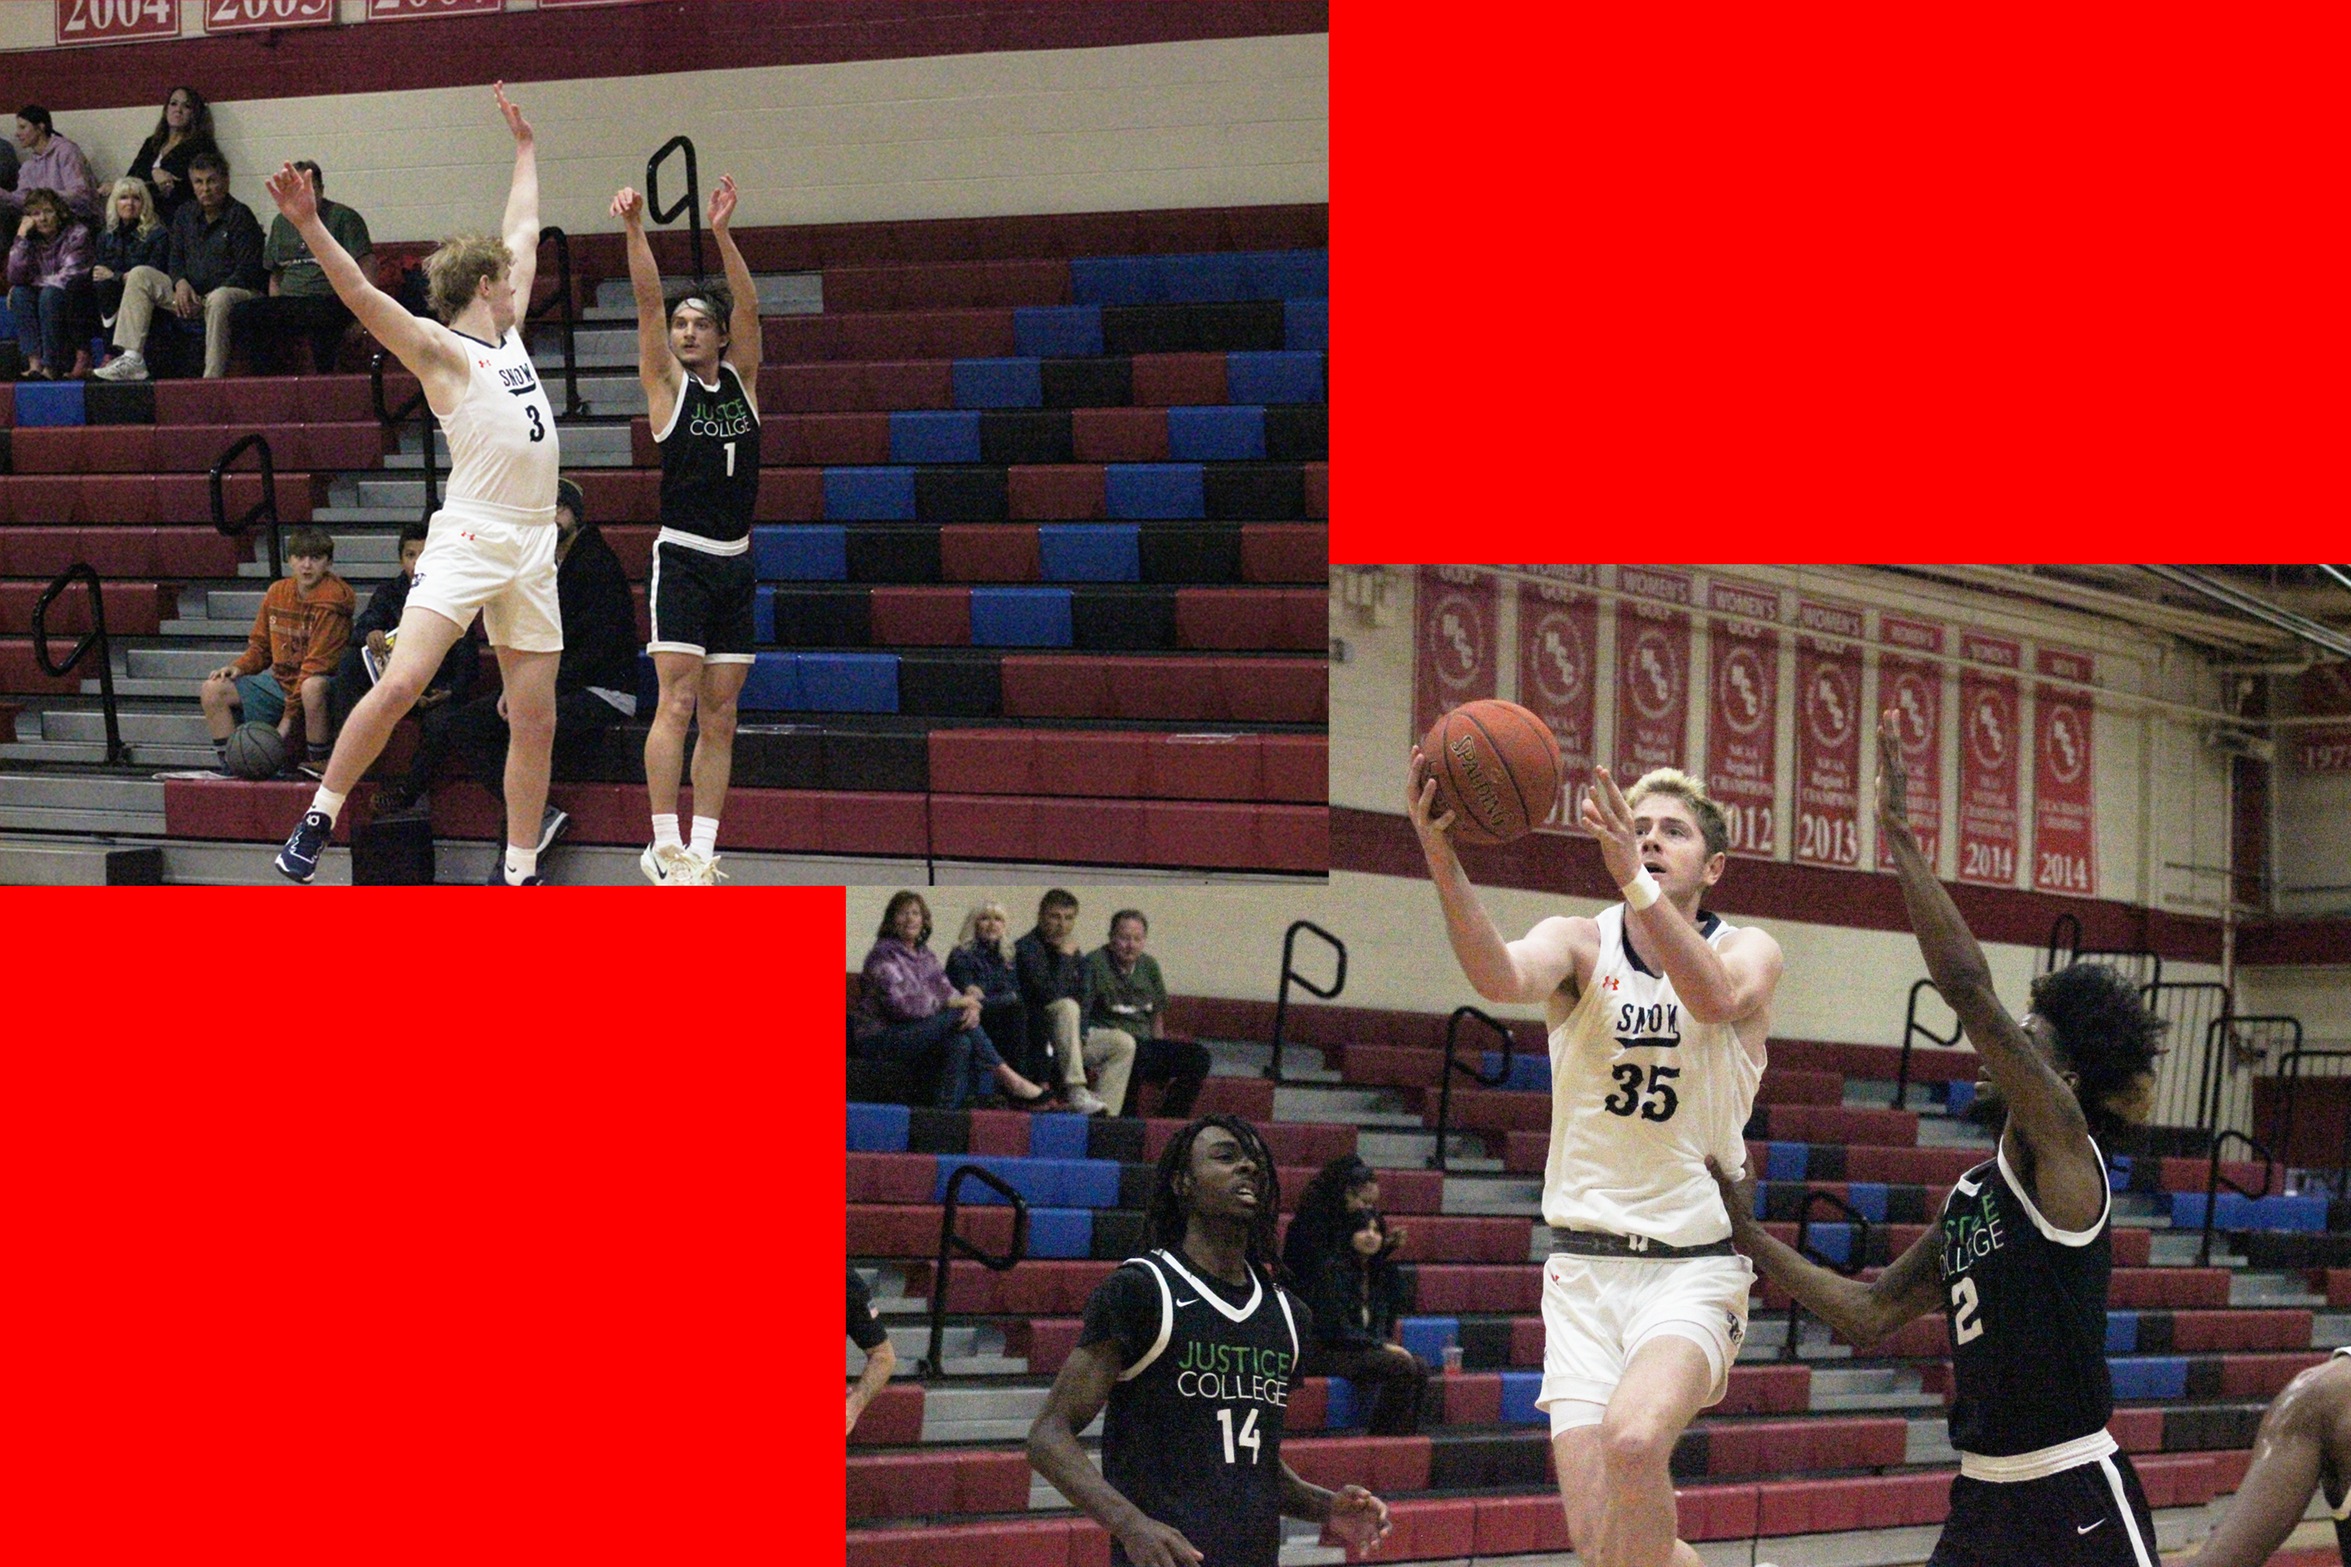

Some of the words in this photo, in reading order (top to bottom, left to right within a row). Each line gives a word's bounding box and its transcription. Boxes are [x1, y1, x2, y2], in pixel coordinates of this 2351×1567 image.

[498, 363, 535, 387] SNOW
[525, 404, 545, 443] 3
[723, 442, 736, 477] 1
[1715, 588, 1777, 620] WOMEN'S
[1450, 734, 1514, 818] SPALDING
[1727, 803, 1773, 850] 012
[1800, 813, 1859, 864] 2013
[1964, 841, 2013, 880] 2014
[2039, 851, 2087, 889] 2014
[1604, 1062, 1680, 1123] 35
[1939, 1219, 2004, 1281] OLLEGE
[1951, 1277, 1984, 1345] 2
[1179, 1341, 1291, 1381] JUSTICE
[1178, 1370, 1288, 1408] COLLEGE
[1217, 1408, 1261, 1465] 14
